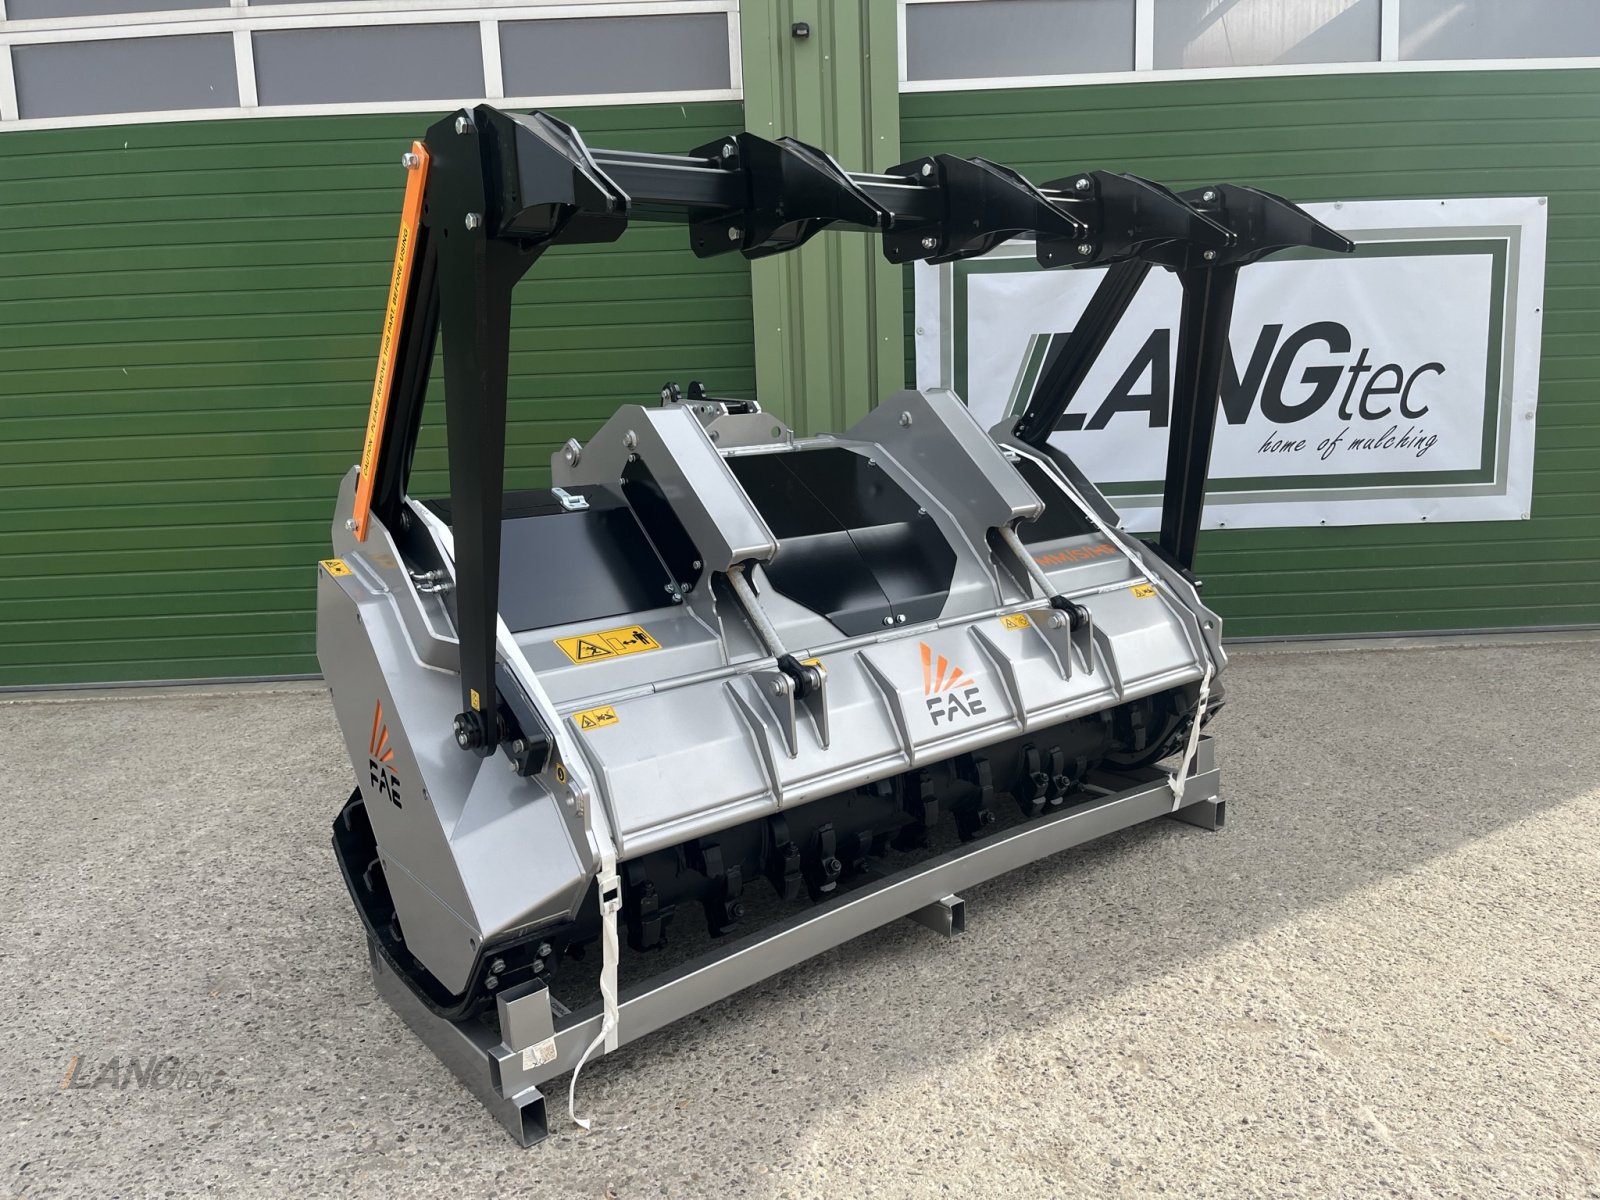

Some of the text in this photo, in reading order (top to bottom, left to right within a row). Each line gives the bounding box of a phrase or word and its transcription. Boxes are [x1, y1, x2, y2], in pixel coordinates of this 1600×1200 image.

[364, 440, 373, 476] CAUTION
[371, 401, 380, 433] PLEASE
[376, 360, 387, 398] REMOVE
[383, 336, 391, 357] THIS
[393, 264, 403, 306] BEFORE
[400, 228, 408, 261] USING
[1258, 425, 1438, 460] home of mulching
[926, 687, 987, 726] FAE
[370, 759, 402, 809] FAE
